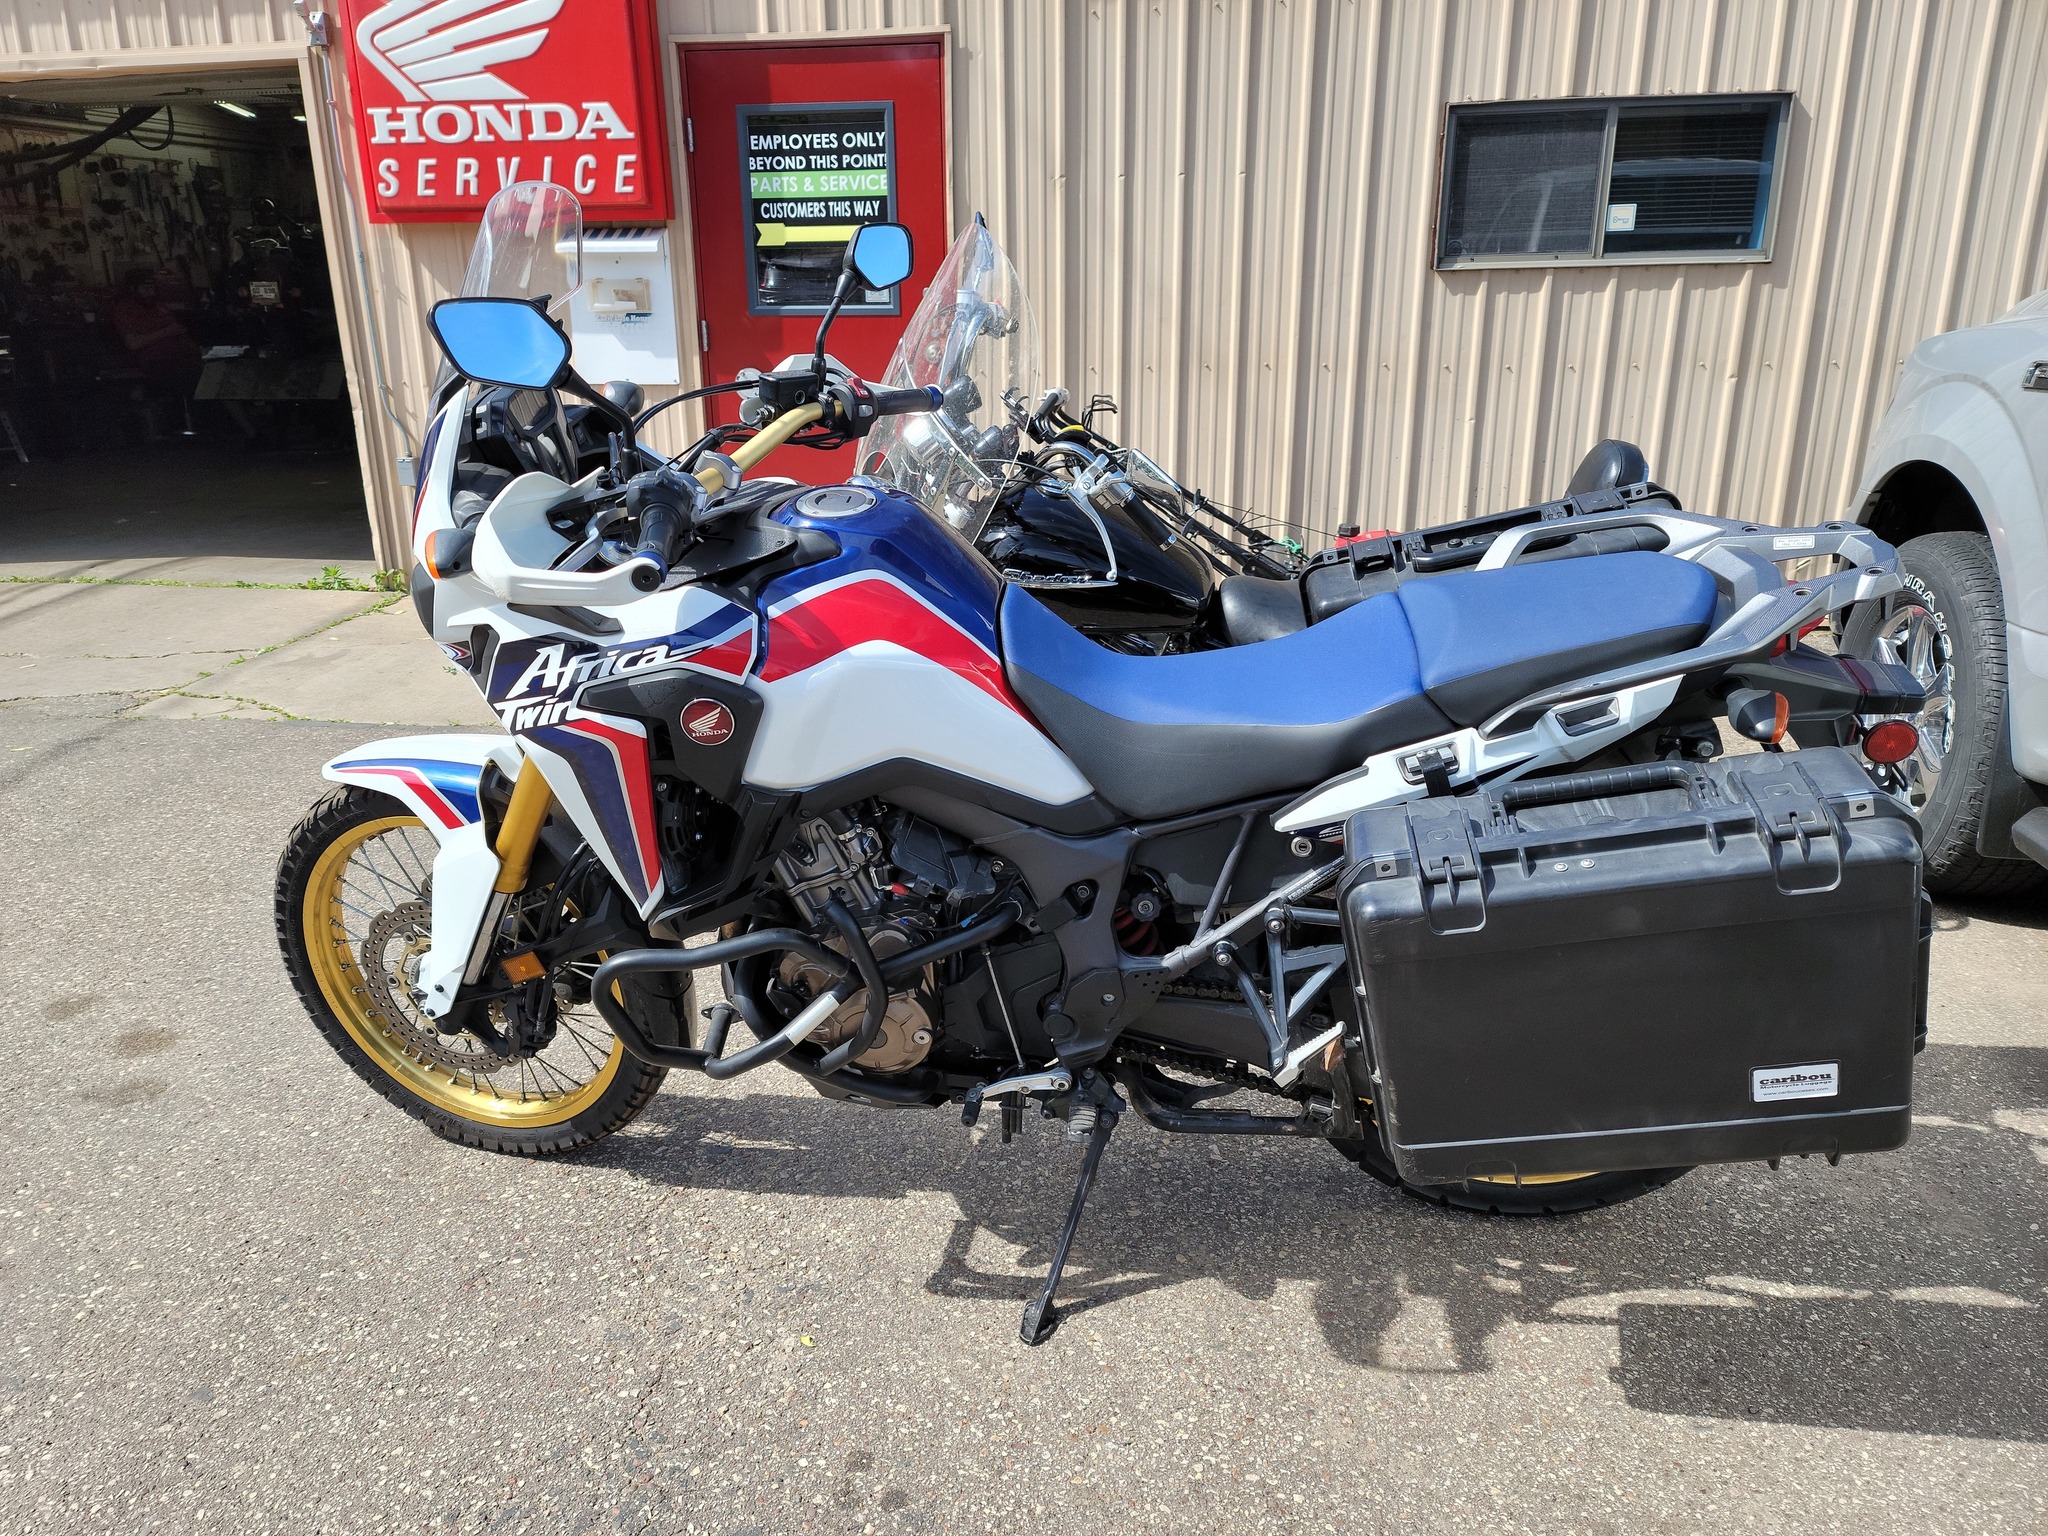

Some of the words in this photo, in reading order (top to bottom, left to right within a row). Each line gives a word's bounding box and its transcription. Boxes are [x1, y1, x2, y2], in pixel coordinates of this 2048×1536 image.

[367, 101, 635, 144] HONDA
[750, 133, 838, 150] EMPLOYEES
[842, 131, 886, 148] ONLY
[749, 155, 806, 170] BEYOND
[809, 154, 838, 169] THIS
[842, 153, 887, 168] POINT!
[378, 154, 637, 198] SERVICE
[751, 175, 798, 193] PARTS
[803, 177, 815, 192] &
[820, 174, 887, 191] SERVICE
[760, 201, 826, 219] CUSTOMERS
[828, 200, 851, 217] THIS
[853, 200, 880, 217] WAY
[505, 643, 702, 699] Africa
[493, 695, 573, 735] Twin
[692, 729, 729, 738] HONDA
[1759, 1073, 1832, 1085] caribou
